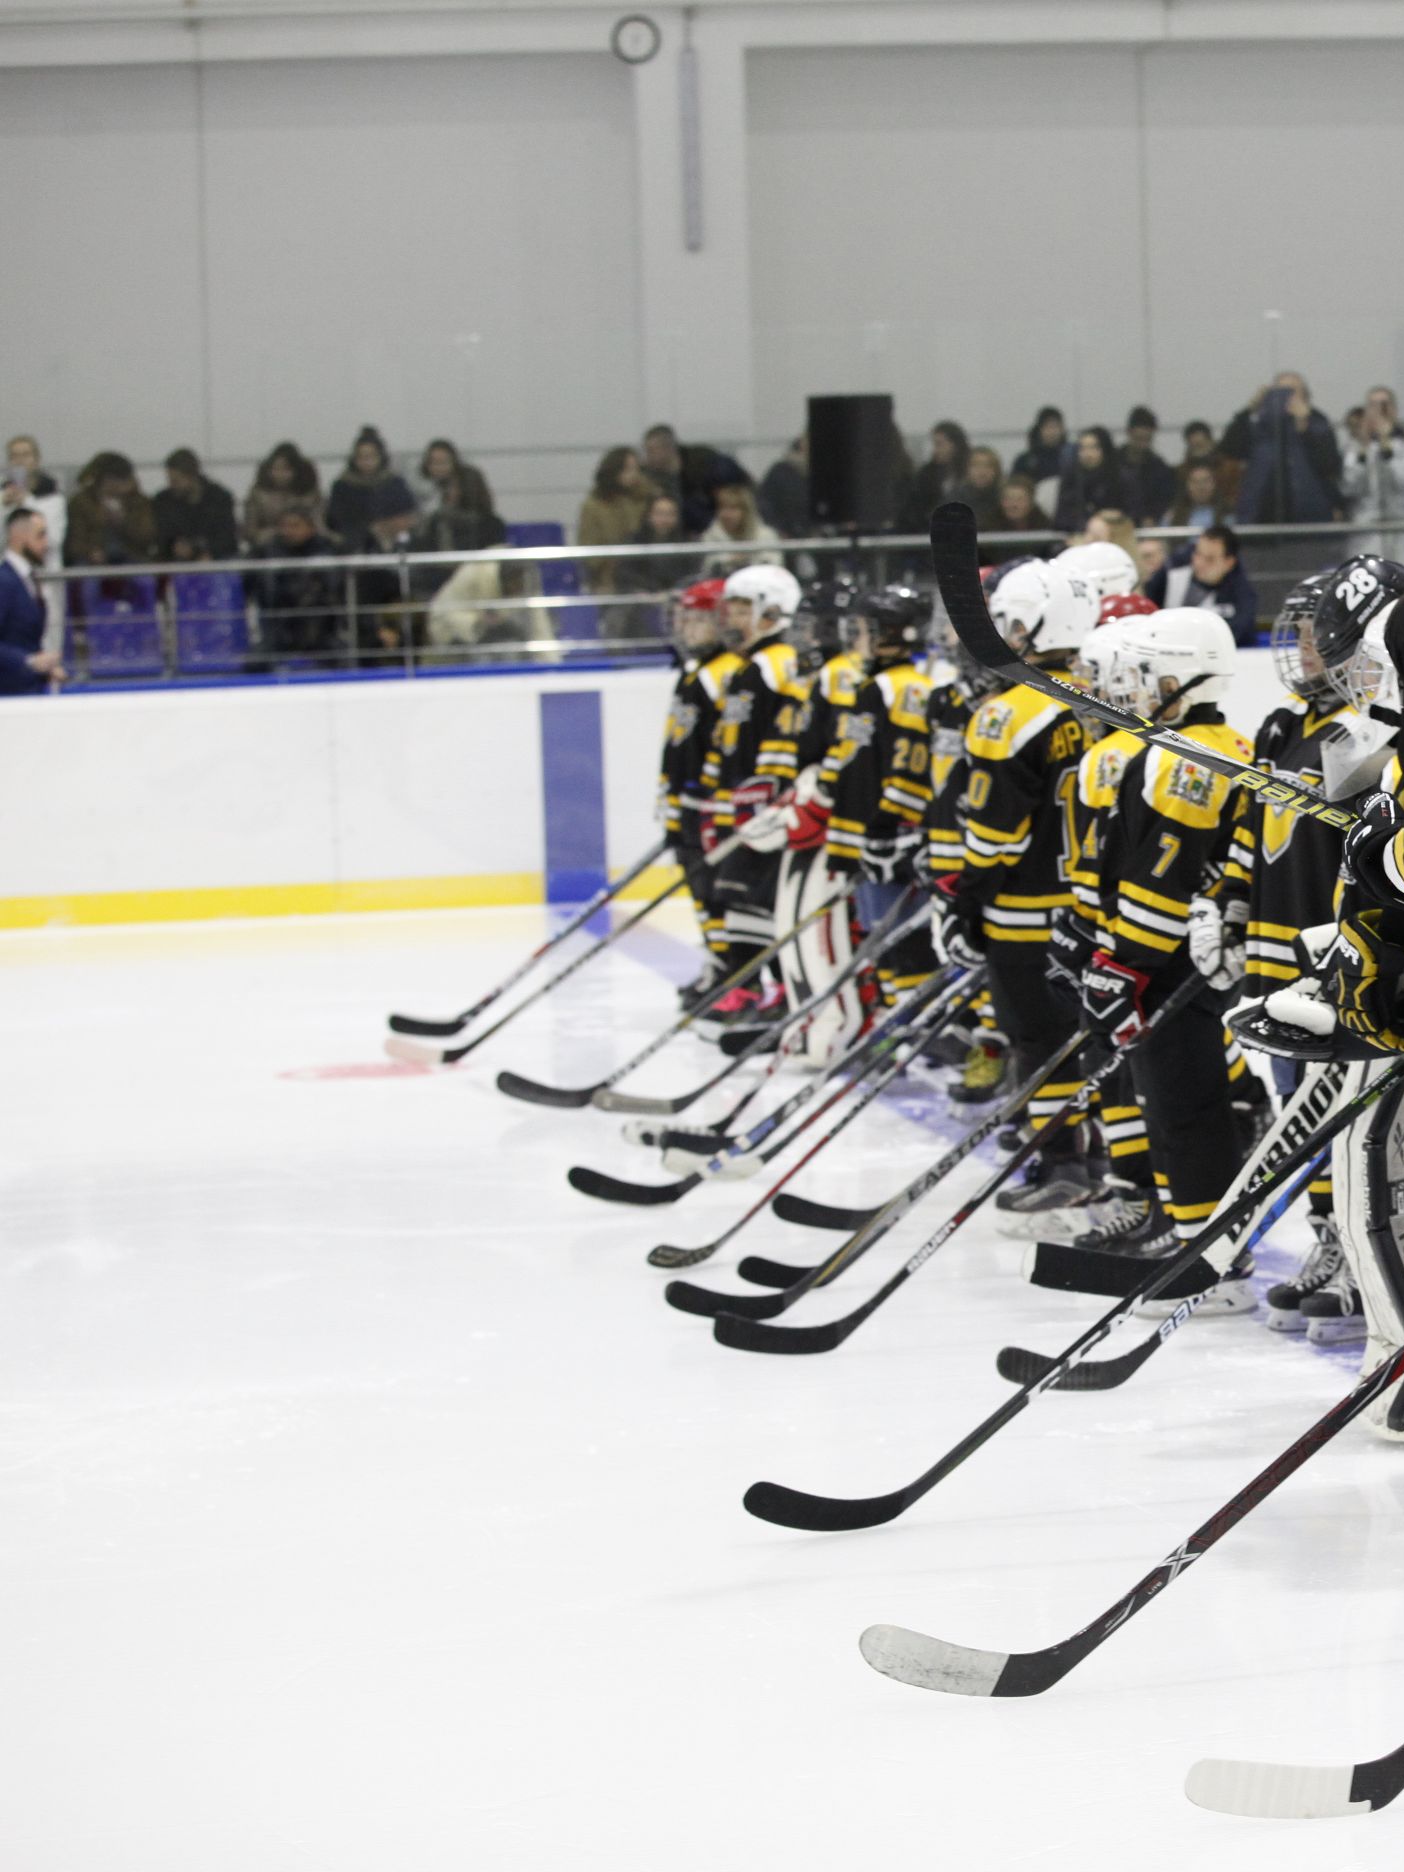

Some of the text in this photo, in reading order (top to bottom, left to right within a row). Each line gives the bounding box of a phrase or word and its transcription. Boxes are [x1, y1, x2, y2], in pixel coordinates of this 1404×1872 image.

[1335, 567, 1378, 612] 28
[892, 736, 929, 774] 20
[1151, 832, 1182, 878] 7
[908, 1115, 1001, 1202] EASTON
